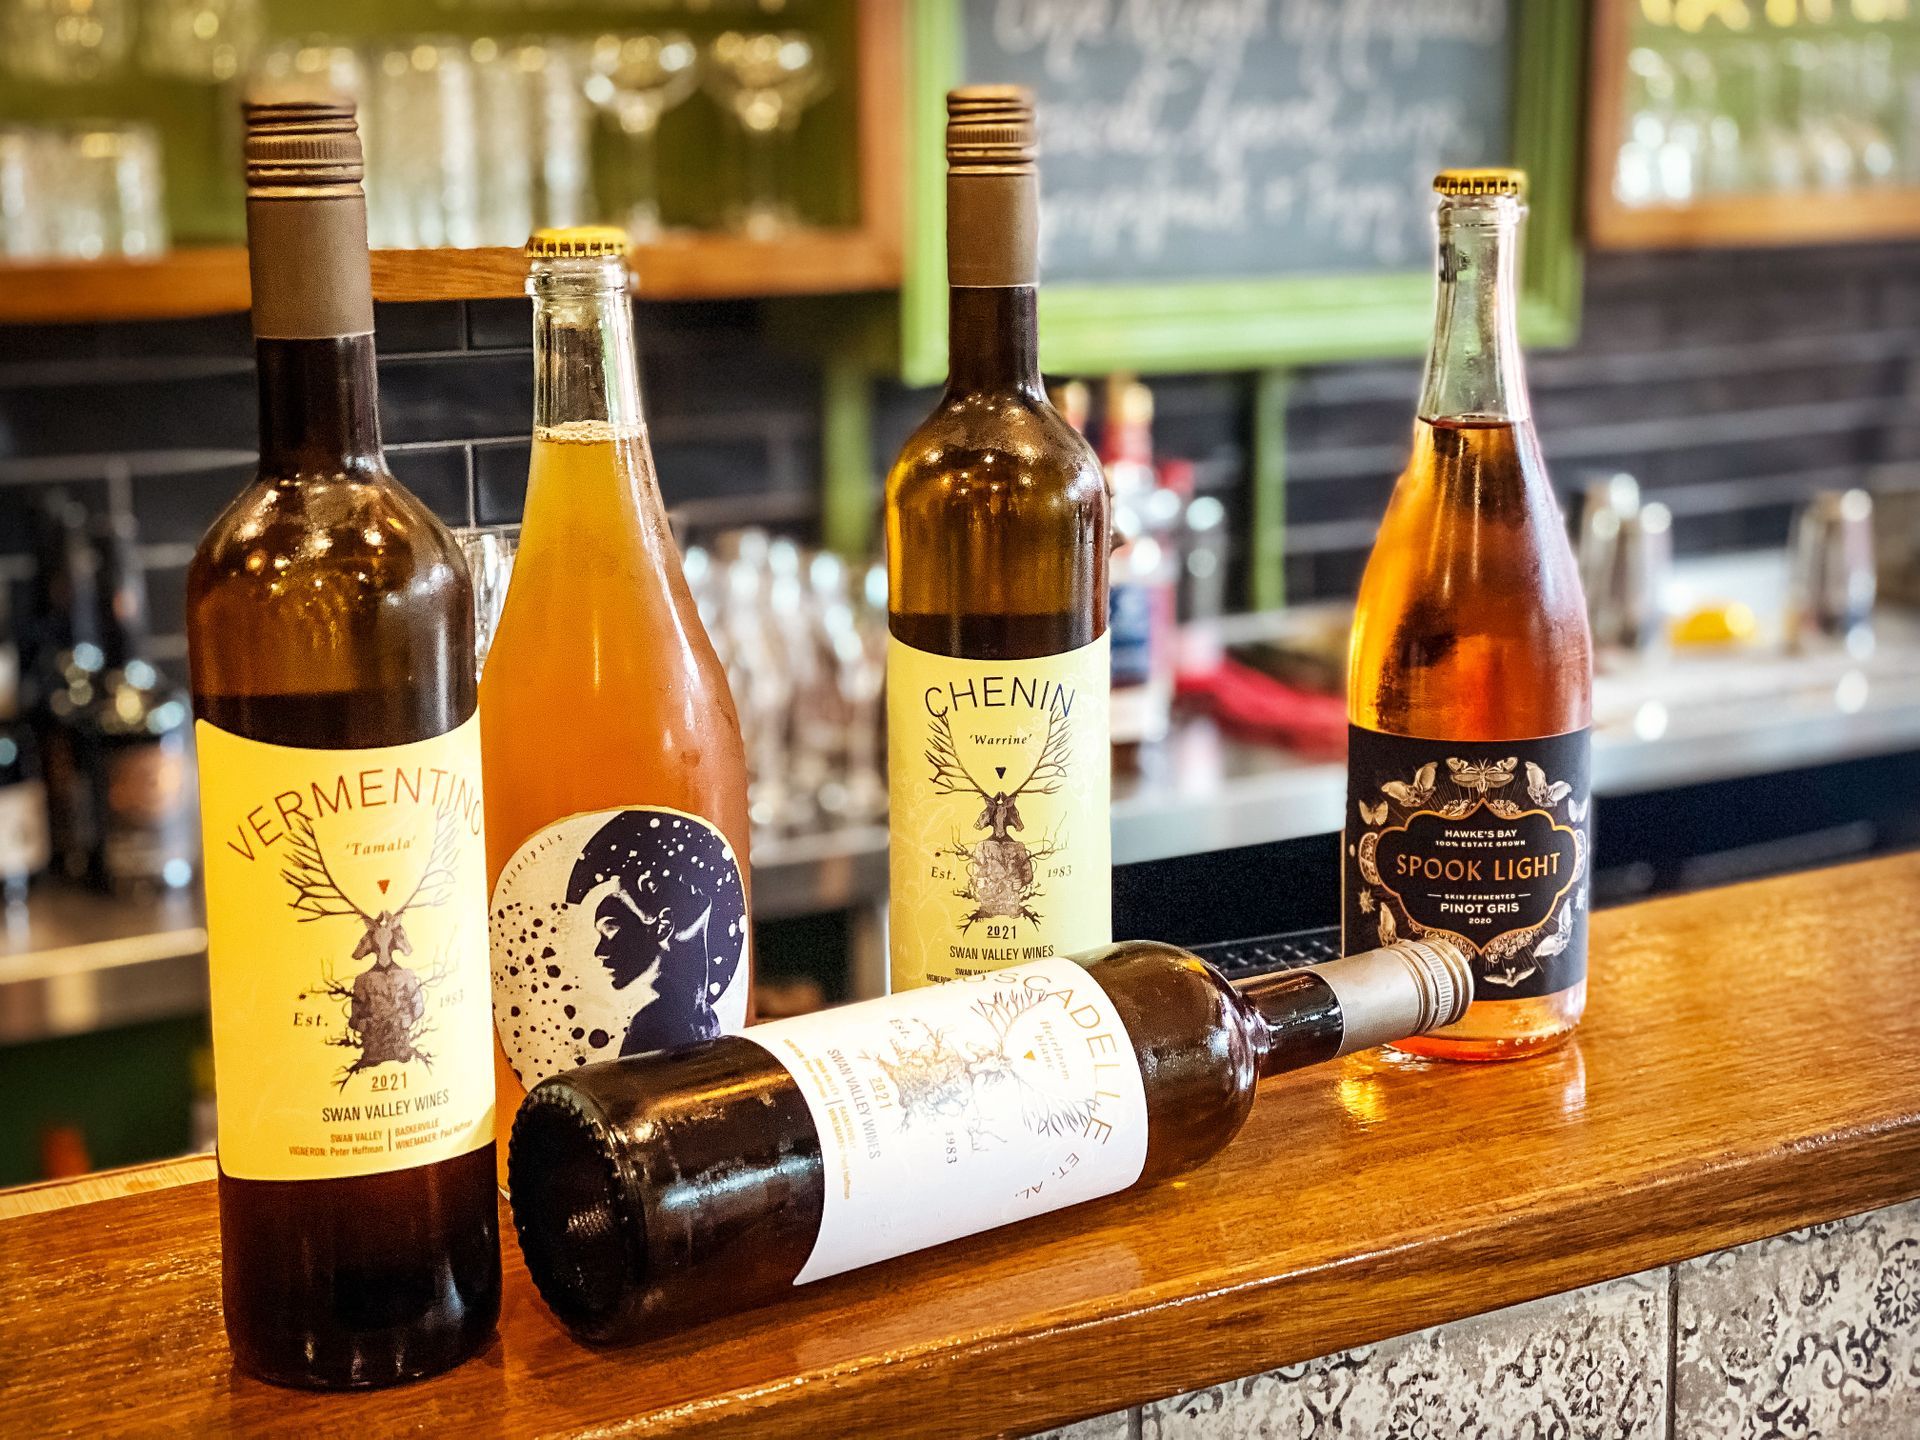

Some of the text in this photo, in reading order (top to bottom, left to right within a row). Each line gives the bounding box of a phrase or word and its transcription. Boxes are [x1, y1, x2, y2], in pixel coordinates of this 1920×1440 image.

[925, 677, 1075, 717] CHENIN
[227, 767, 482, 862] VERMENTINO
[1445, 829, 1518, 838] HAWKE'S BAY
[1461, 840, 1494, 848] ESTATE
[1496, 839, 1526, 848] GROWN
[931, 864, 1073, 881] Est. 1983
[1397, 852, 1561, 882] SPOOK LIGHT
[1440, 902, 1520, 914] PINOT GRIS
[986, 925, 1017, 940] 2021
[949, 944, 1054, 961] SWAN VALLEY WINES
[292, 1011, 329, 1027] Est.
[956, 972, 1121, 1145] USCADELLE
[371, 1071, 408, 1092] 2021
[868, 1076, 893, 1110] 2021
[321, 1088, 450, 1123] SWAN VALLEY WINES
[826, 1048, 881, 1160] SWAN VALLEY WINES
[354, 1130, 383, 1142] VALLEY
